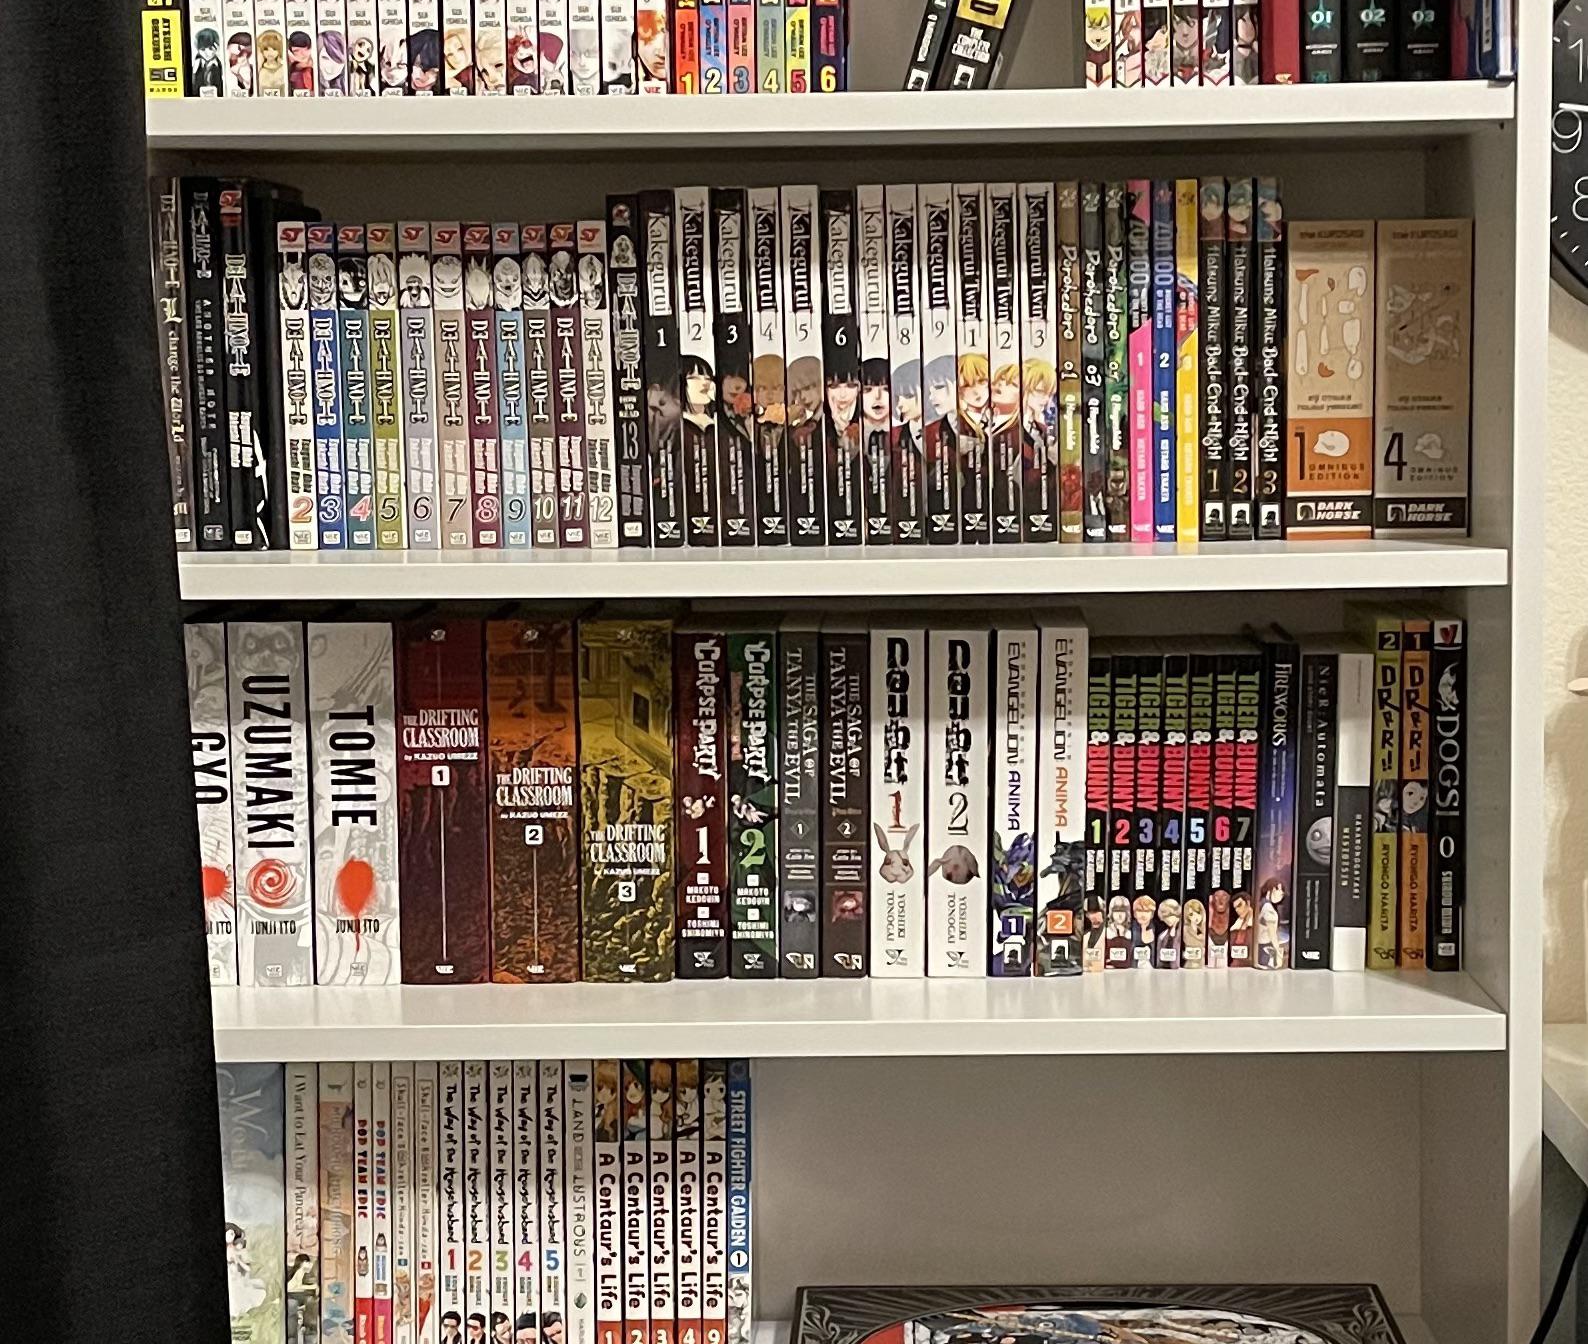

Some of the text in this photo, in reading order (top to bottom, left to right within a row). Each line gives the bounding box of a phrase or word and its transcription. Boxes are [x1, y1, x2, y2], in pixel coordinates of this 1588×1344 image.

[1311, 10, 1333, 23] 01
[705, 69, 722, 94] 2
[821, 66, 836, 92] 6
[1552, 109, 1582, 153] 9
[647, 210, 671, 315] Kakegurui
[791, 208, 812, 312] Kakegurui
[990, 196, 1012, 324] Kakegurui Twin
[1155, 262, 1172, 285] 100
[1060, 246, 1078, 340] Dorohedoro
[1207, 247, 1220, 347] Hatsune Miku
[657, 328, 667, 346] 1
[799, 325, 809, 342] 5
[1000, 331, 1011, 348] 2
[1160, 354, 1169, 368] 2
[1295, 432, 1305, 480] 1
[1384, 432, 1407, 480] 4
[1208, 469, 1218, 492] 1
[319, 497, 340, 523] 3
[448, 498, 467, 522] 7
[563, 494, 583, 521] 11
[1316, 511, 1361, 519] HORSE
[1318, 502, 1353, 510] DARK
[1384, 634, 1395, 649] 2
[403, 709, 478, 726] THE DRIFTING
[744, 639, 772, 783] CORPSE PARTY
[1007, 642, 1020, 764] EVANGELION
[1115, 673, 1136, 731] TIGER
[1271, 664, 1291, 746] FIREWORKS
[403, 729, 479, 748] CLASSROOM
[830, 647, 846, 804] TANYA THE EVIL
[847, 673, 862, 777] THE SAGA OF
[192, 732, 228, 805] GYO
[242, 674, 294, 848] UZUMAKI
[329, 705, 377, 827] TOMIE
[436, 770, 444, 783] 1
[1112, 745, 1133, 811] BUNNY
[948, 792, 968, 835] 2
[1008, 771, 1020, 830] ANIMA
[844, 823, 850, 834] 2
[1116, 819, 1129, 844] 2
[739, 829, 766, 868] 2
[1440, 836, 1455, 858] 0
[251, 921, 296, 934] JUNJI ITO
[335, 919, 379, 934] JUNJI ITO
[948, 894, 956, 944] TONOGAI
[958, 897, 967, 940] YOSHIKI
[1008, 919, 1016, 933] 1
[443, 1084, 460, 1243] The Way of the Househusband
[730, 1090, 746, 1247] STREET FIGHTER GAIDEN
[680, 1151, 698, 1308] A Centaur's Life
[448, 1249, 455, 1270] 1
[546, 1249, 559, 1270] 5
